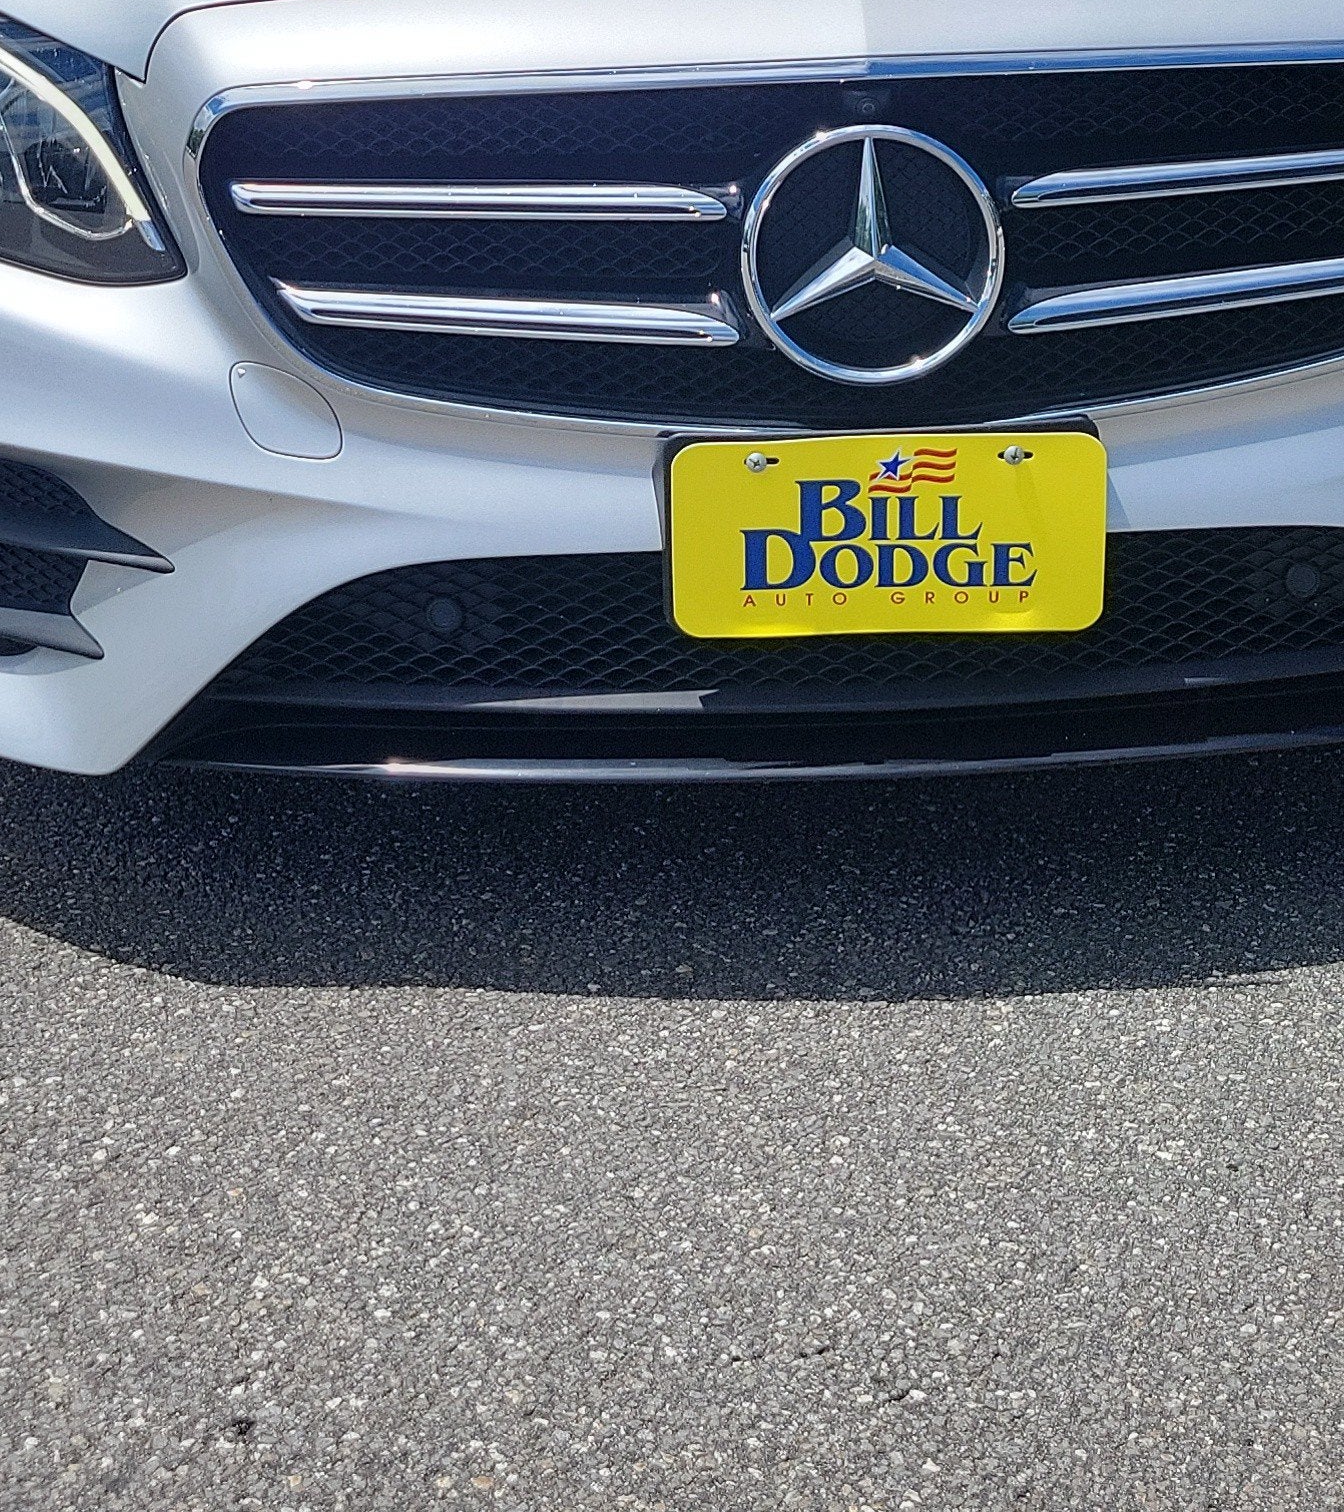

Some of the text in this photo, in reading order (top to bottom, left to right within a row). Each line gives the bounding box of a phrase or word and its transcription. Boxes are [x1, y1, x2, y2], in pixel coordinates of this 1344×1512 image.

[795, 477, 984, 542] BILL
[740, 528, 1038, 591] DODGE
[742, 590, 1030, 608] AUTO GROUP
